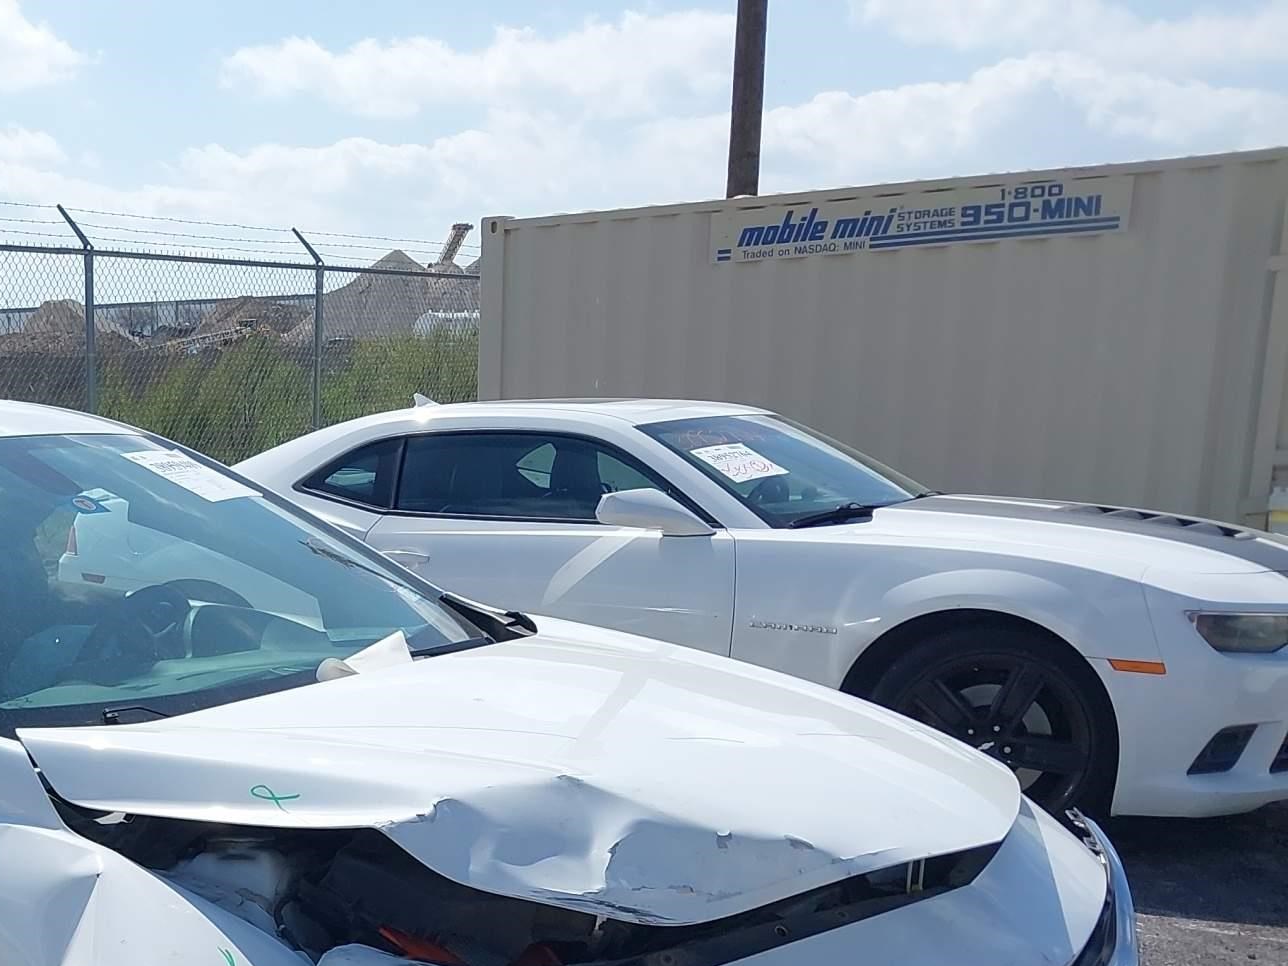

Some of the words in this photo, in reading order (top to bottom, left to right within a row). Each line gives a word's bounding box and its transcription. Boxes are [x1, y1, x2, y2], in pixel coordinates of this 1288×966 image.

[897, 206, 956, 222] STORAGE
[960, 194, 1103, 227] 950-MINI
[737, 208, 828, 248] mobile
[830, 208, 898, 240] mini
[896, 218, 956, 233] SYSTEMS
[743, 249, 774, 260] Traded
[778, 248, 791, 257] on
[794, 242, 840, 256] NASDAQ:
[843, 240, 866, 251] MINI
